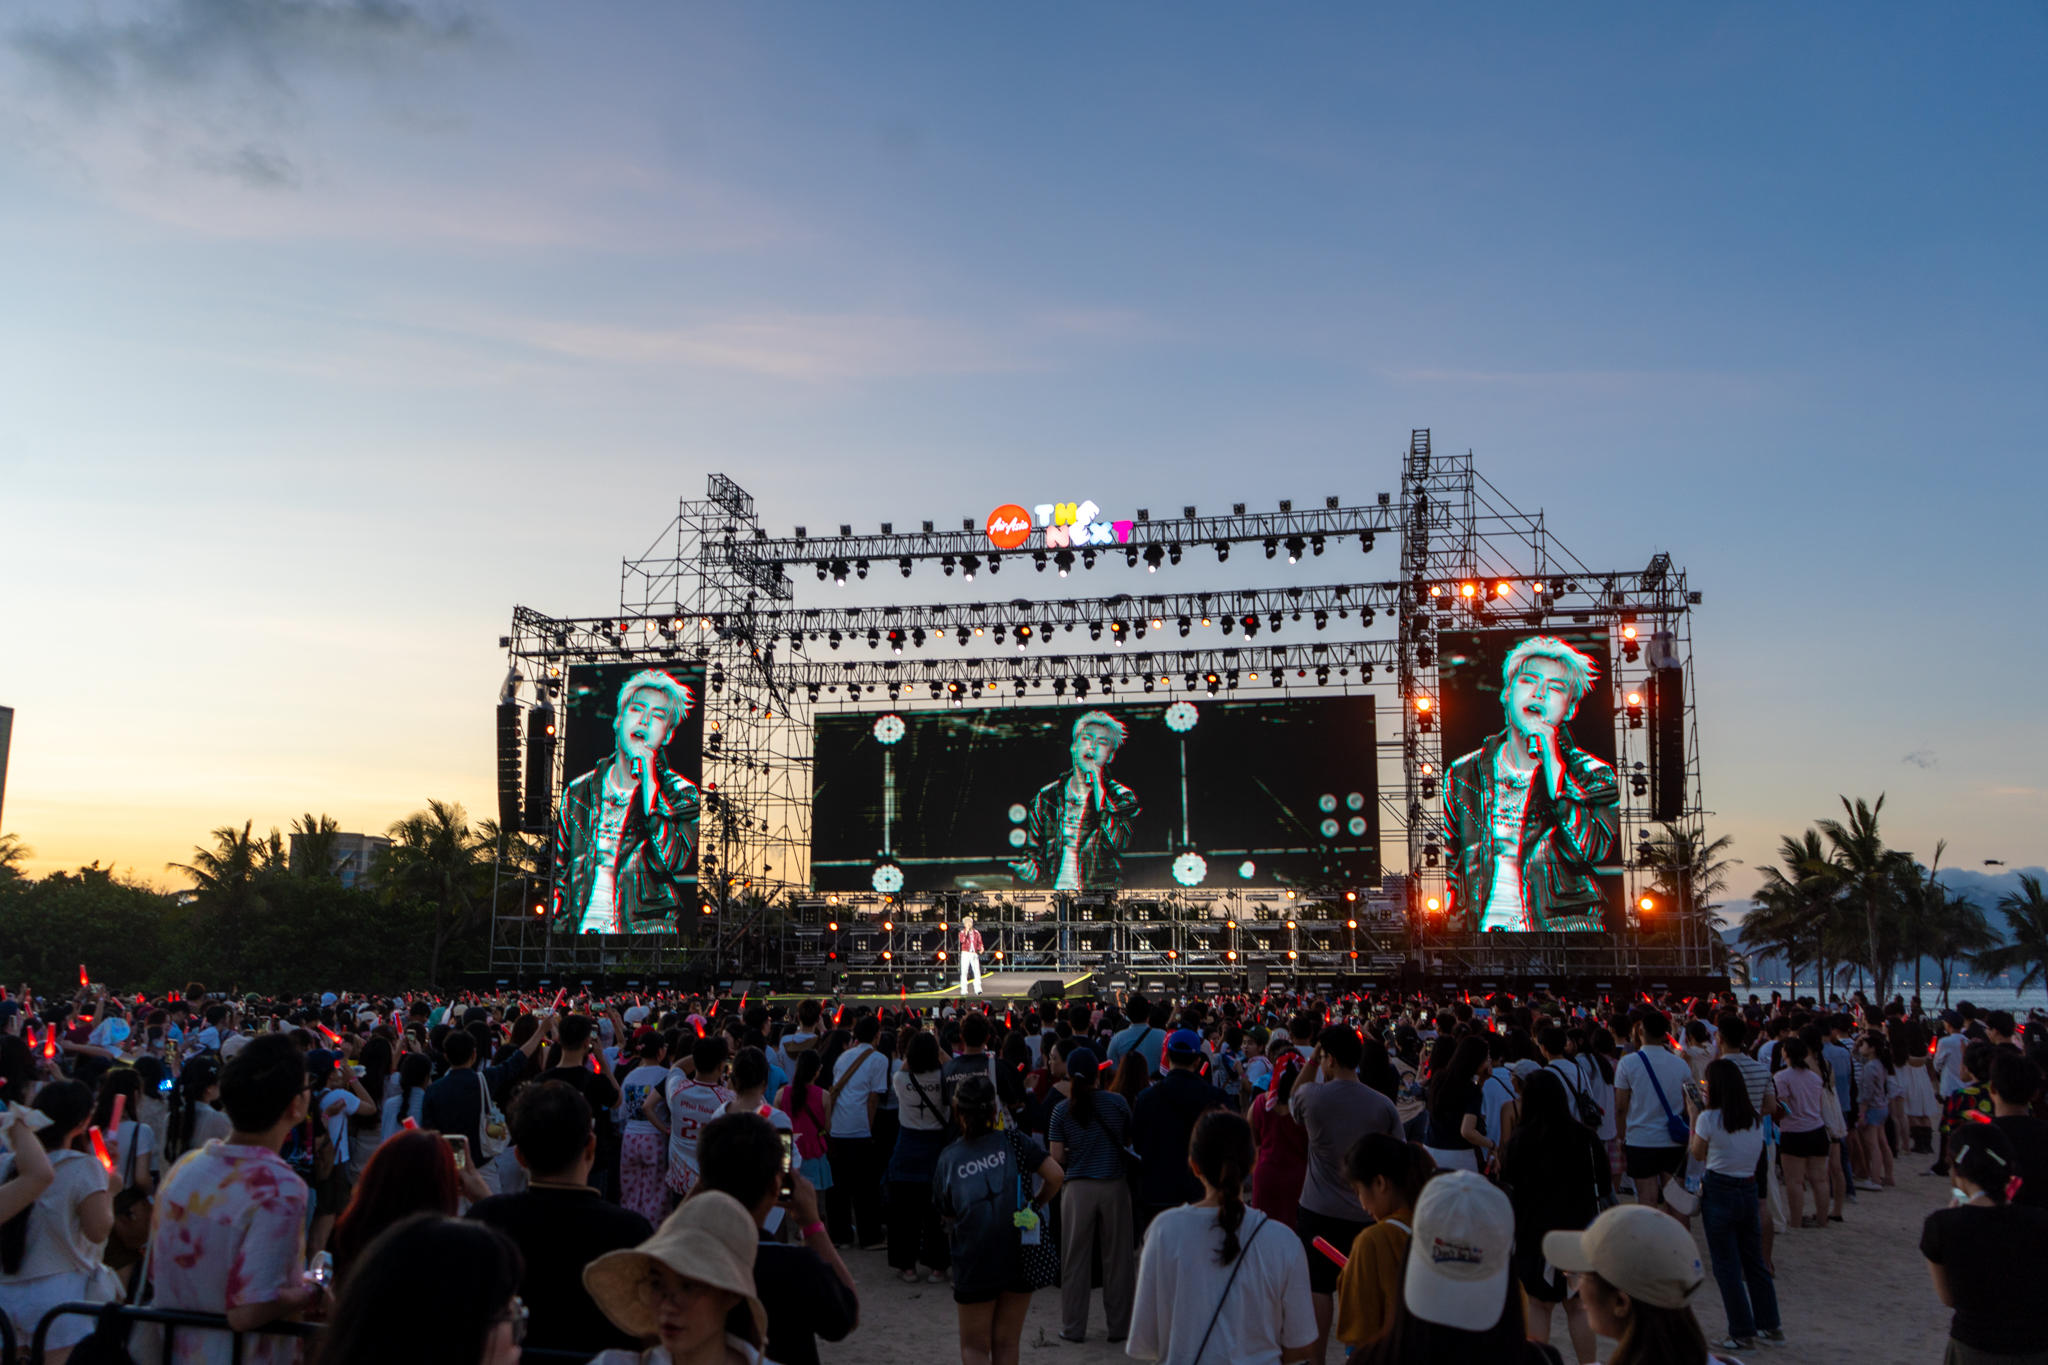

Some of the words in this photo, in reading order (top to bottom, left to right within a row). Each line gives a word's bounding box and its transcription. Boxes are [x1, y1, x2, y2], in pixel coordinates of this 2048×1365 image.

[989, 516, 1029, 536] AirAsia
[1034, 499, 1100, 527] THE
[1046, 519, 1134, 548] NEXT
